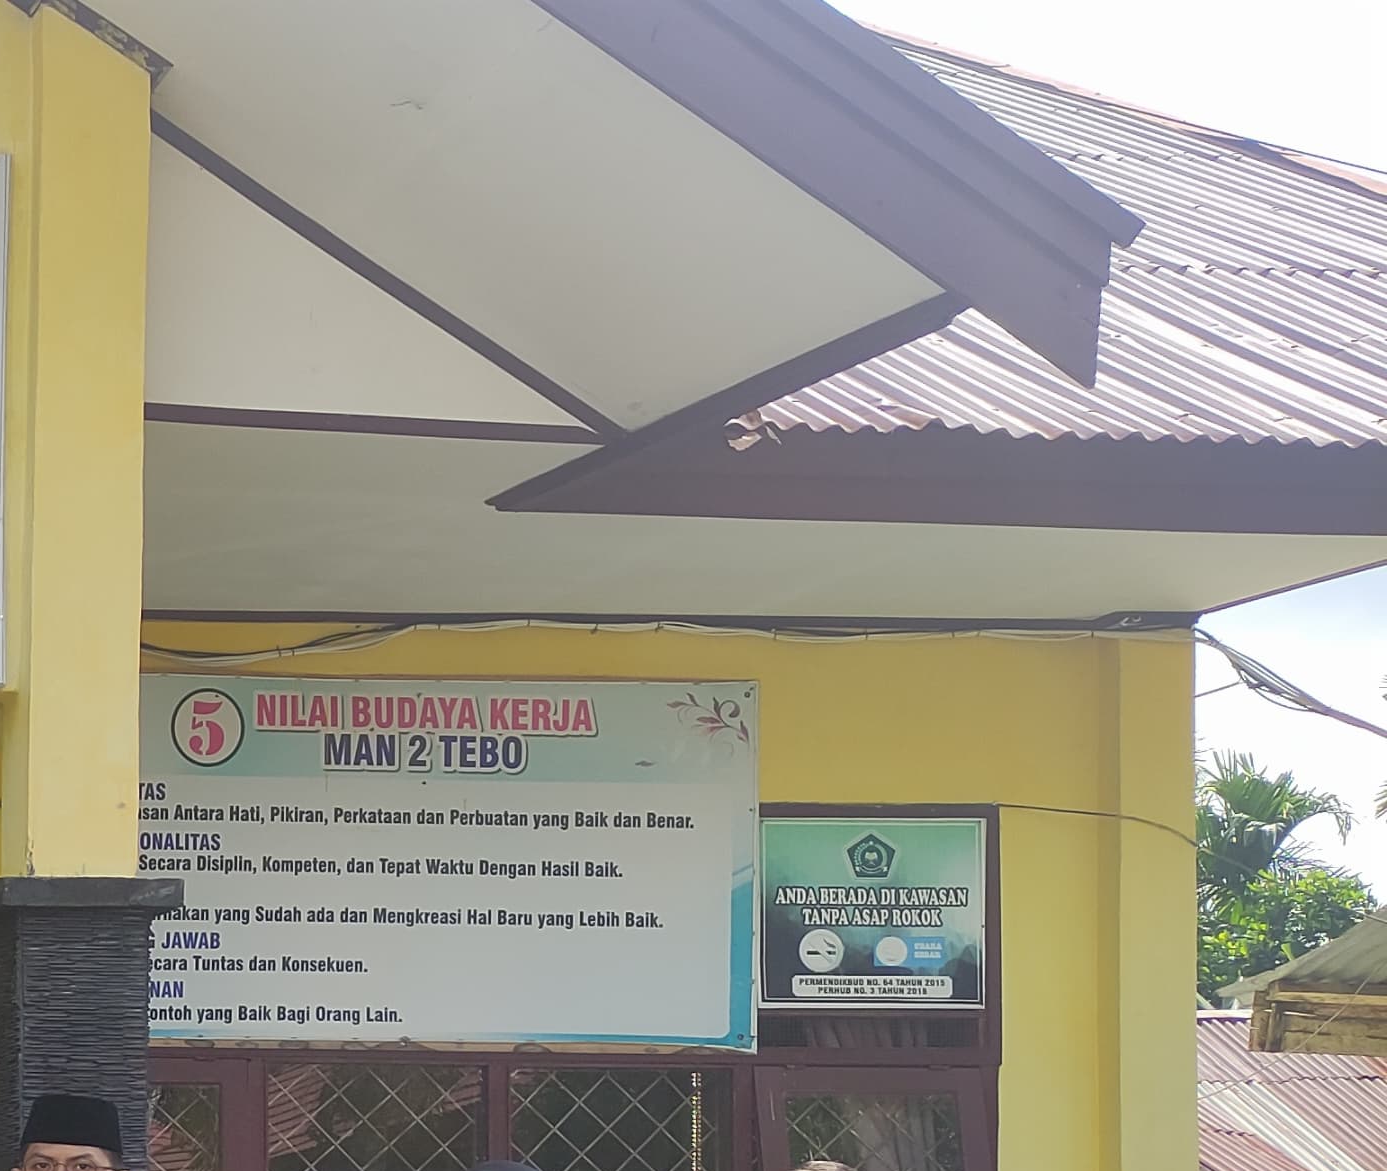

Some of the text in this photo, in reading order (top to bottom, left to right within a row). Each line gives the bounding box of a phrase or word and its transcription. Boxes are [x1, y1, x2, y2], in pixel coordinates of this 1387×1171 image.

[256, 694, 594, 732] NILAI BUDAYA KERJA
[189, 700, 225, 756] 5
[324, 733, 523, 769] MAN 2 TEBO
[173, 804, 694, 830] Antara Hati, Pikiran, Perkataan dan Perbuatan yang Baik dan Benar.
[139, 854, 623, 879] Secara Disiplin, Kompeten, dan Tepat Waktu Dengan Hasil Baik.
[776, 887, 968, 906] ANDA BERADA DI KAWASAN
[214, 908, 250, 925] yang
[255, 905, 301, 922] Sudah
[306, 906, 334, 922] ada
[340, 907, 367, 923] dan
[373, 907, 461, 927] Mengkreasi
[467, 909, 491, 925] Hal
[497, 909, 532, 925] Baru
[537, 913, 573, 929] yang
[579, 911, 619, 927] Lebih
[625, 911, 663, 928] Baik.
[802, 908, 943, 926] TANPA ASAP ROKOK
[161, 931, 220, 949] JAWAB
[192, 955, 368, 972] Tuntas dan Konsekuen.
[197, 1005, 402, 1025] yang Baik Bagi Orang Lain.
